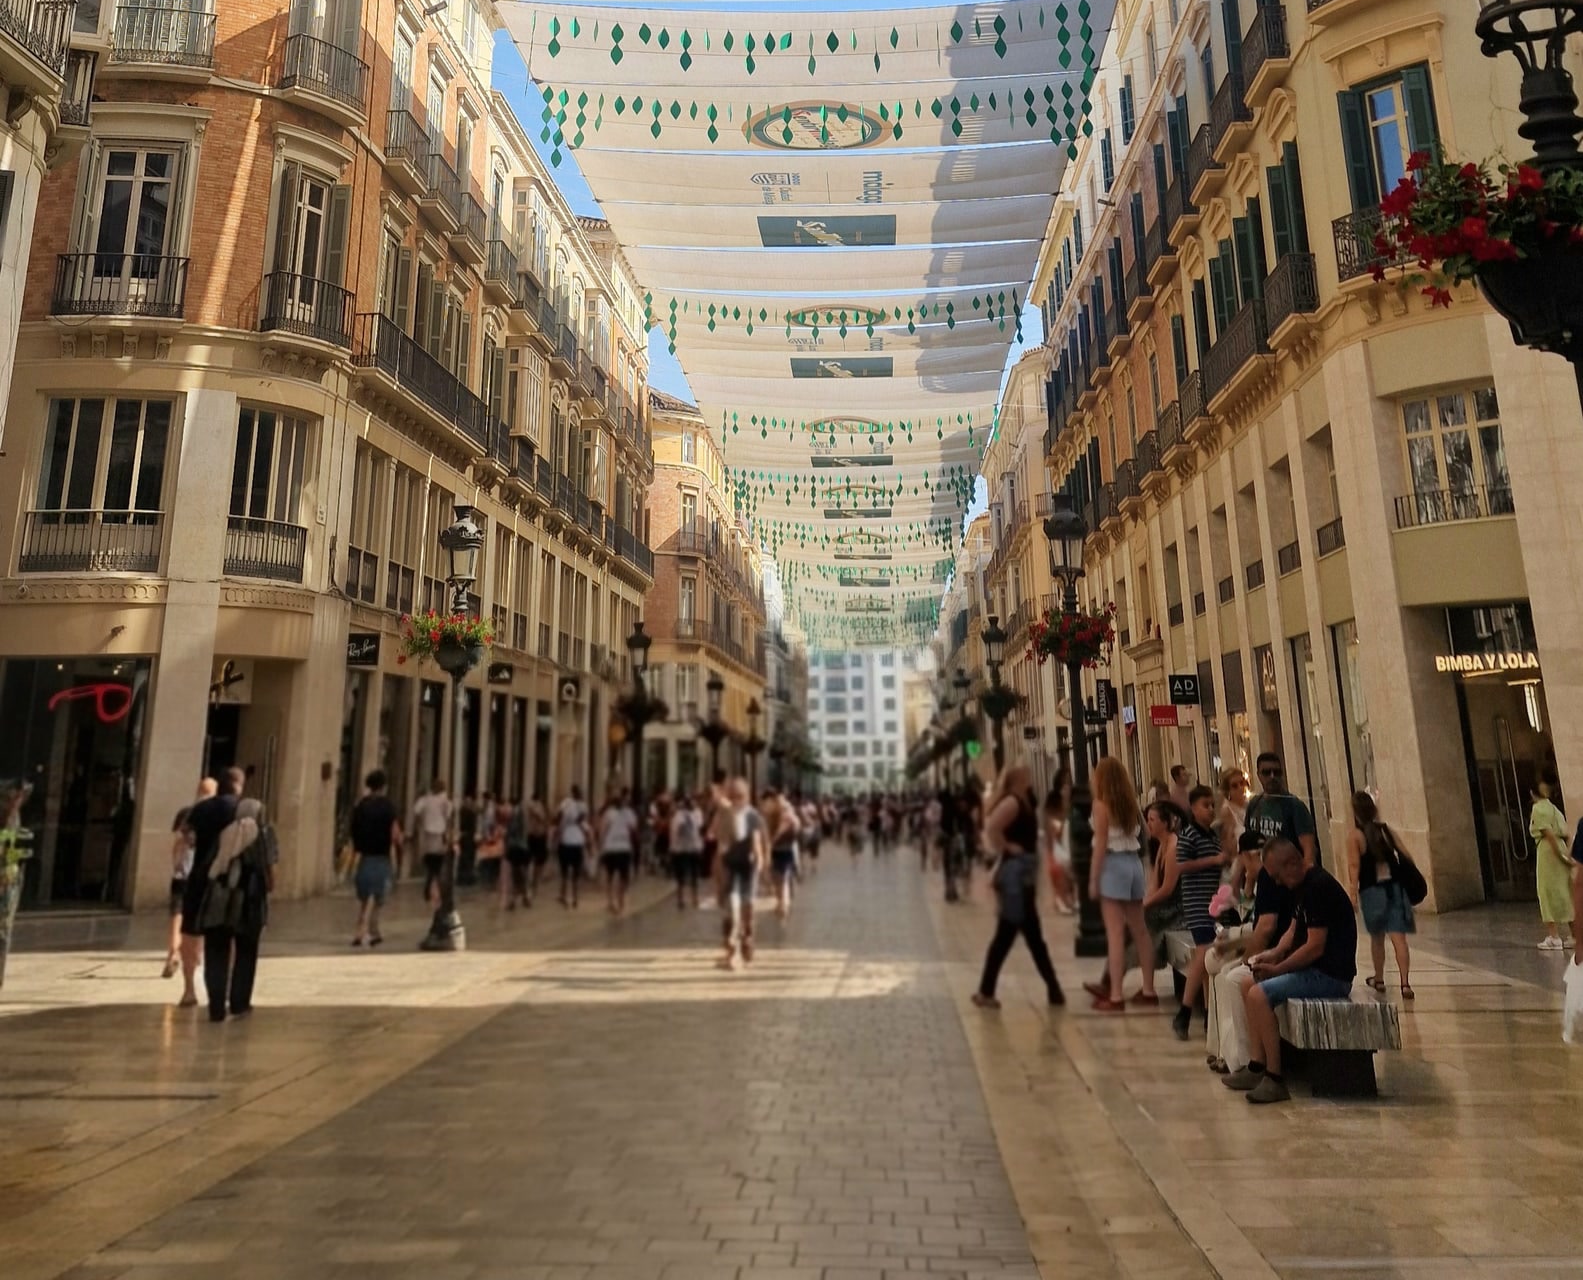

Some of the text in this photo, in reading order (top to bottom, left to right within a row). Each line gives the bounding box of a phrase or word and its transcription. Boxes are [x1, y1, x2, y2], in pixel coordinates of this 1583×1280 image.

[1435, 652, 1539, 672] BIMBA Y LOLA
[1097, 680, 1107, 719] PRIMOR
